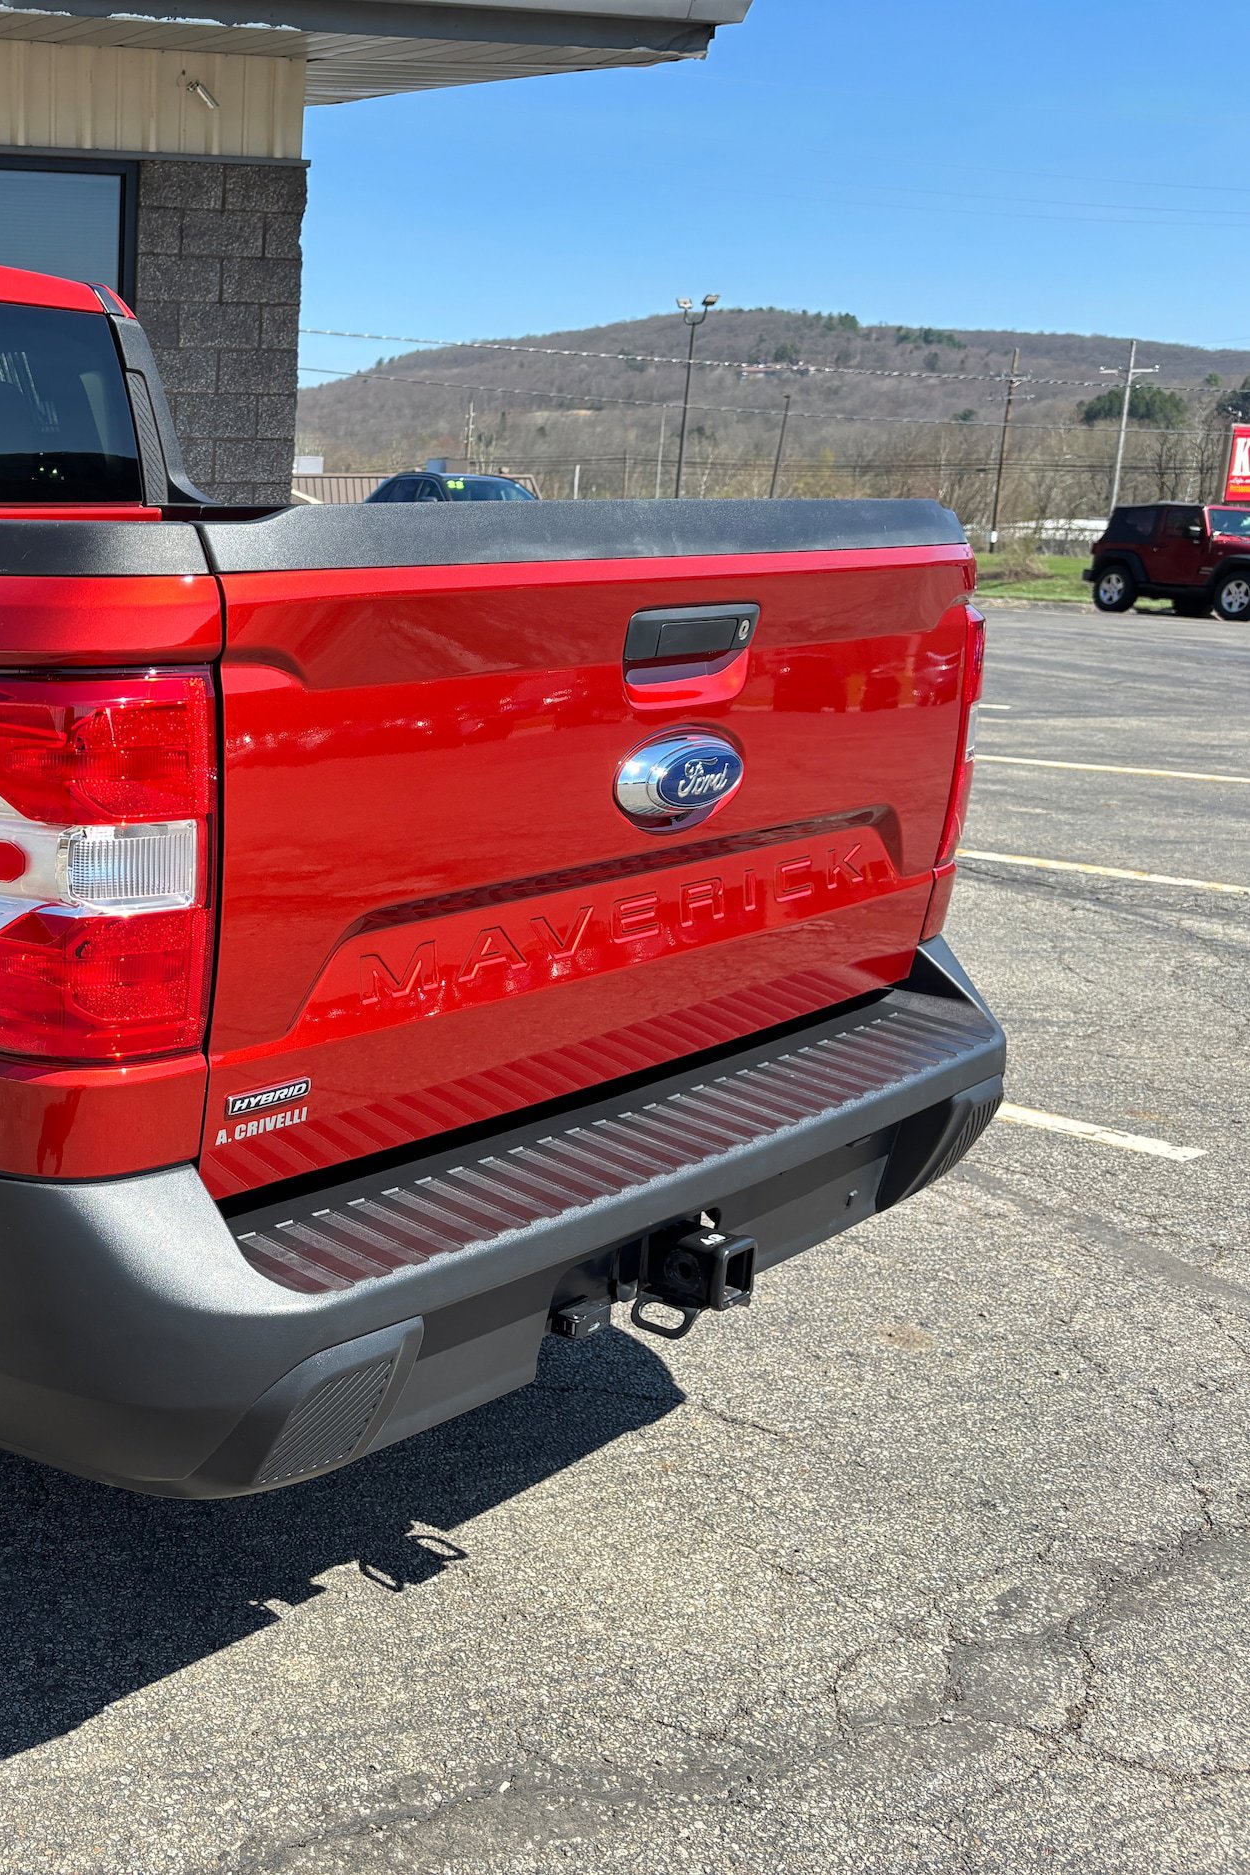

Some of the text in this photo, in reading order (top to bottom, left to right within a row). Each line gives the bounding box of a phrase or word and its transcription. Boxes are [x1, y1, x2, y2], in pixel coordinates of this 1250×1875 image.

[677, 757, 729, 798] Ford
[359, 841, 865, 1005] MAVERICK
[233, 1082, 308, 1112] HYBRID
[215, 1106, 308, 1146] A. CRIVELLI
